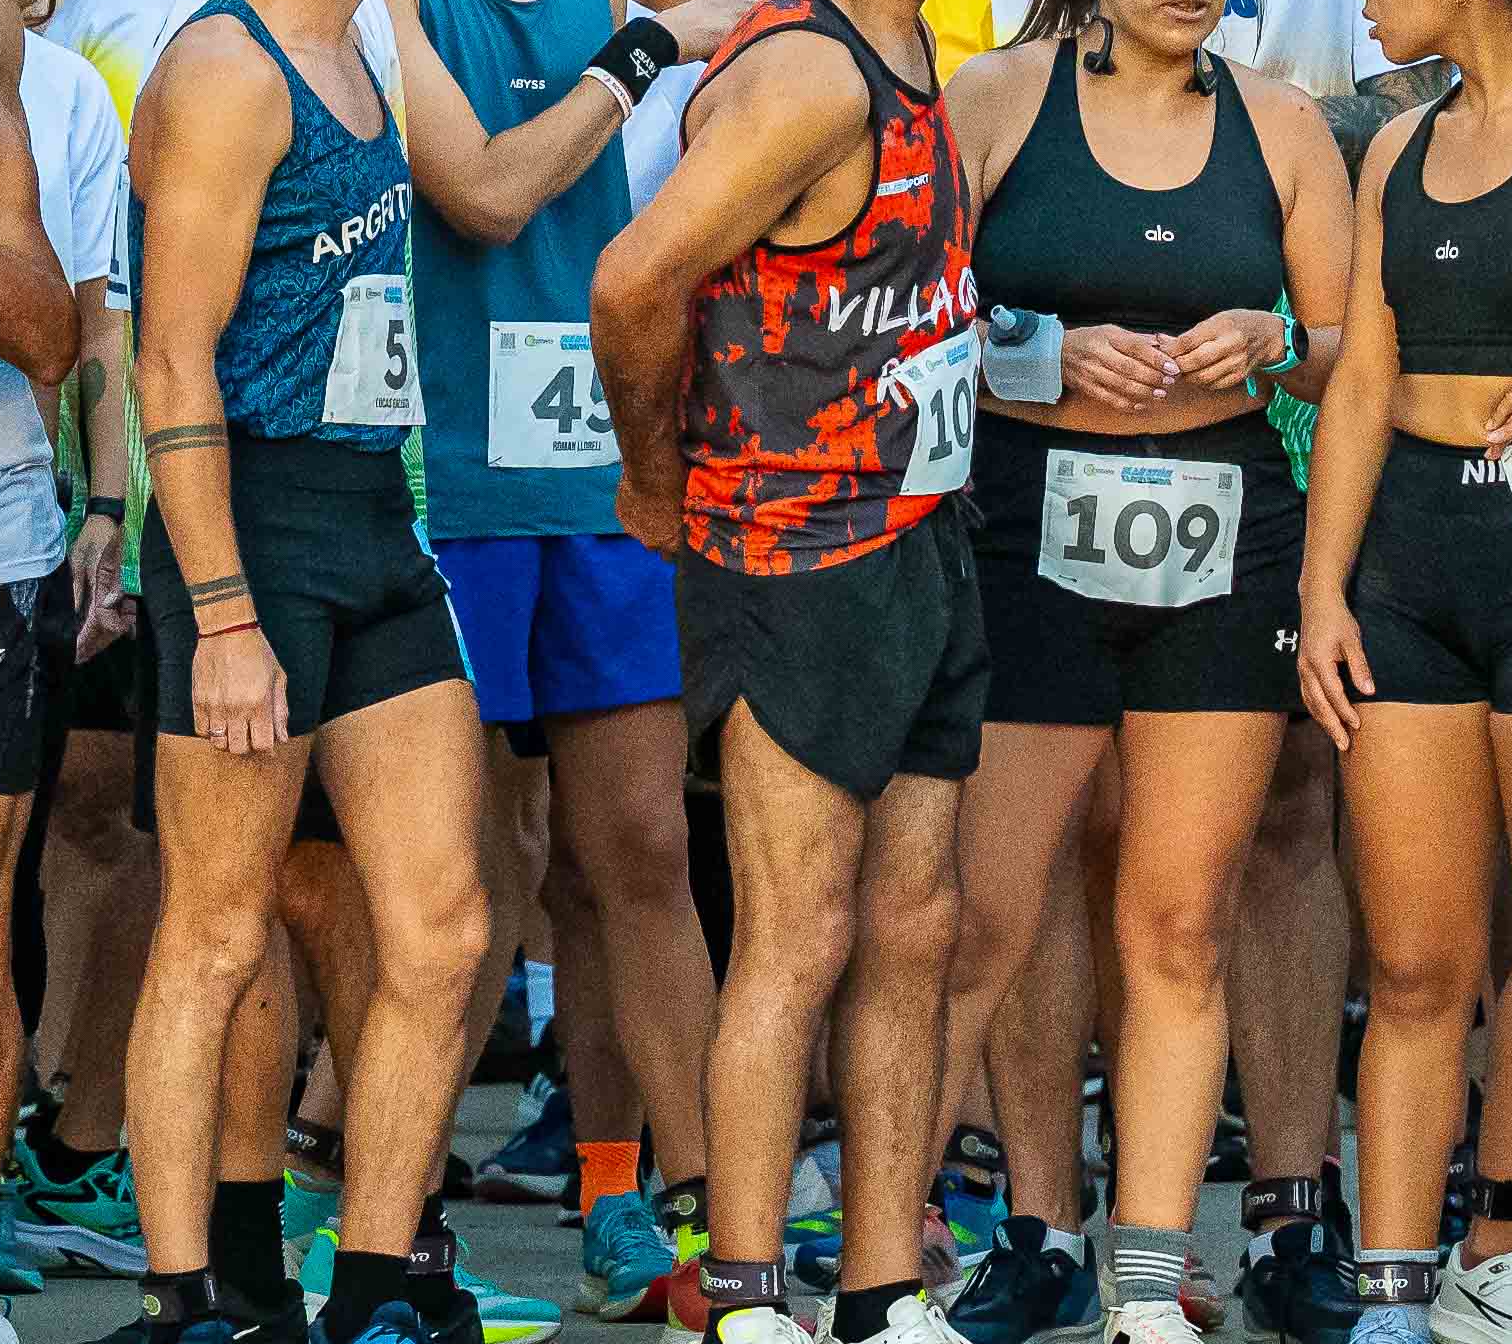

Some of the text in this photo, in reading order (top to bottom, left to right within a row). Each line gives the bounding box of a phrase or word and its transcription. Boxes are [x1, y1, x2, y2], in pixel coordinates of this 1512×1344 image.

[510, 78, 546, 89] ABYSS
[1144, 224, 1176, 242] alo
[1435, 239, 1459, 260] alo
[827, 284, 960, 335] VILLA
[1065, 496, 1220, 572] 109
